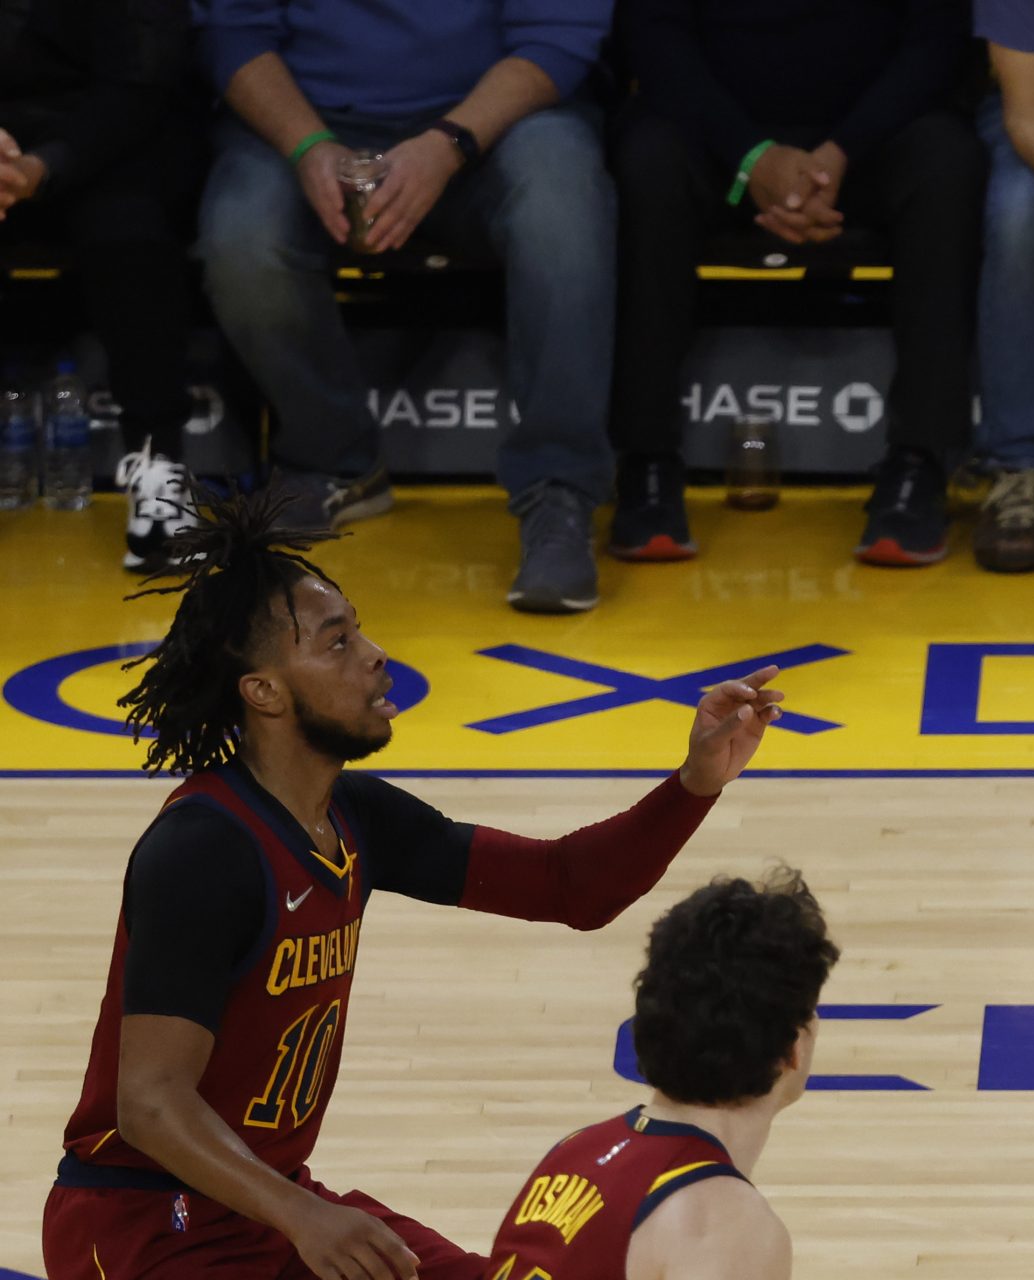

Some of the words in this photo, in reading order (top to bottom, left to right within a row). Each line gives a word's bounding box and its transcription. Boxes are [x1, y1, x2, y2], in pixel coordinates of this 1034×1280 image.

[367, 388, 499, 428] ASE
[681, 383, 823, 426] HASE
[266, 918, 360, 996] CLEVELAN
[244, 999, 341, 1129] 10
[515, 1174, 605, 1245] OSMAN
